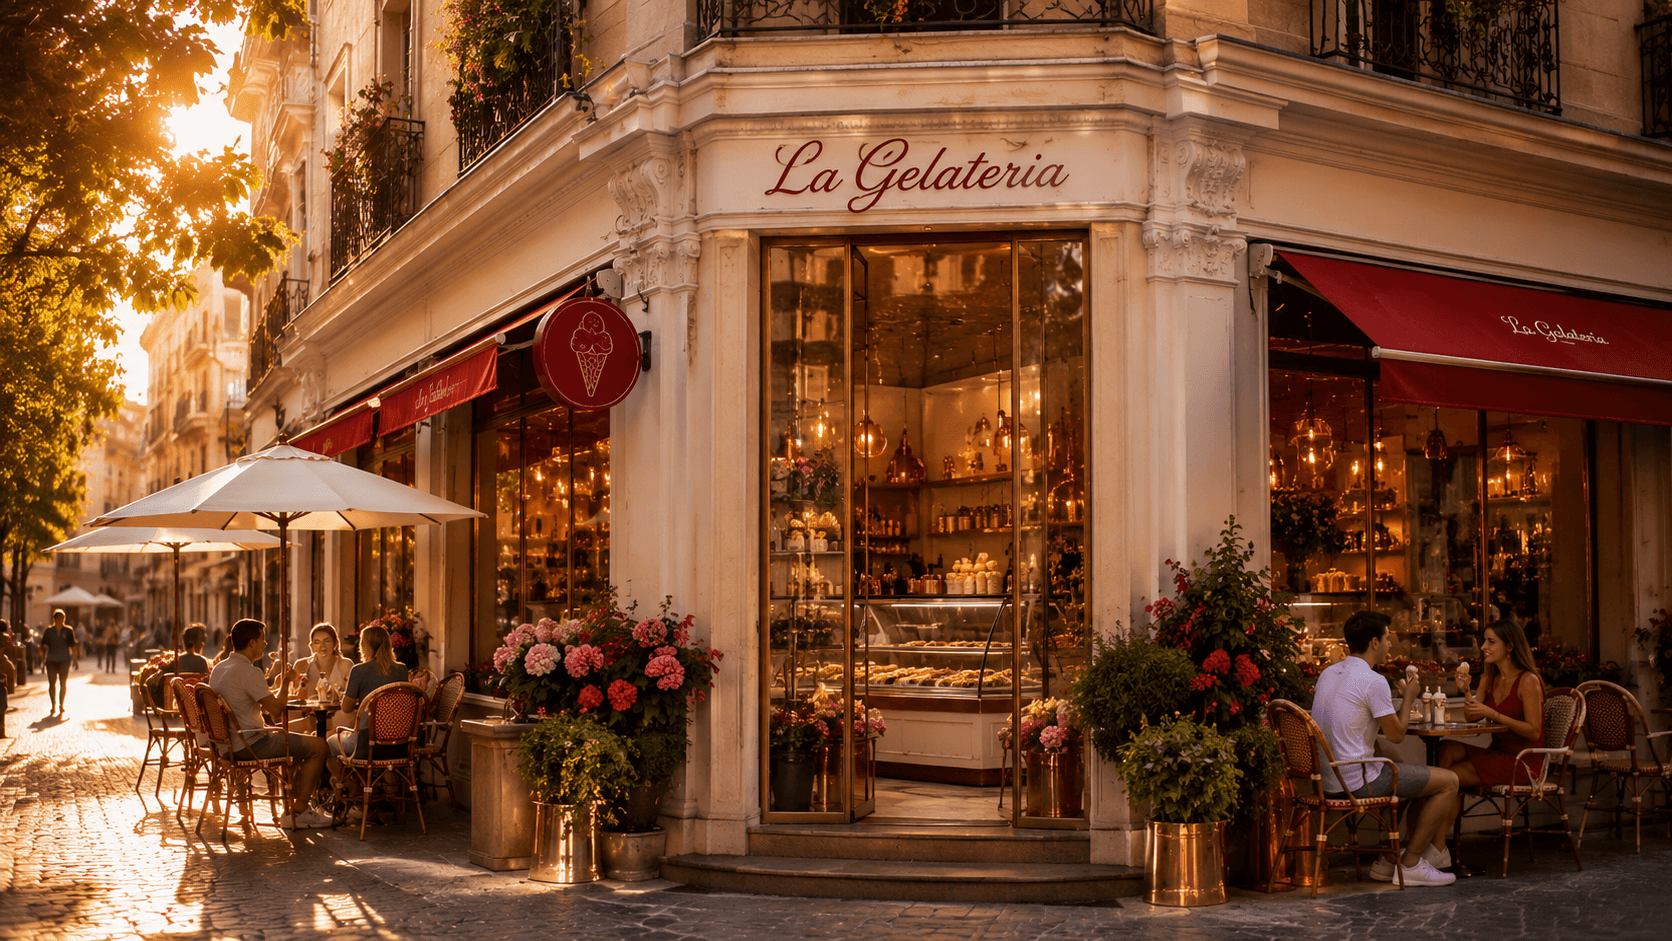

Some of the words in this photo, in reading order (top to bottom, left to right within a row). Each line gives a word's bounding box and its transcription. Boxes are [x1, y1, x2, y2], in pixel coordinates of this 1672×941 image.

[764, 140, 844, 196] La
[847, 138, 1070, 213] Gelateria
[1500, 315, 1536, 335] La
